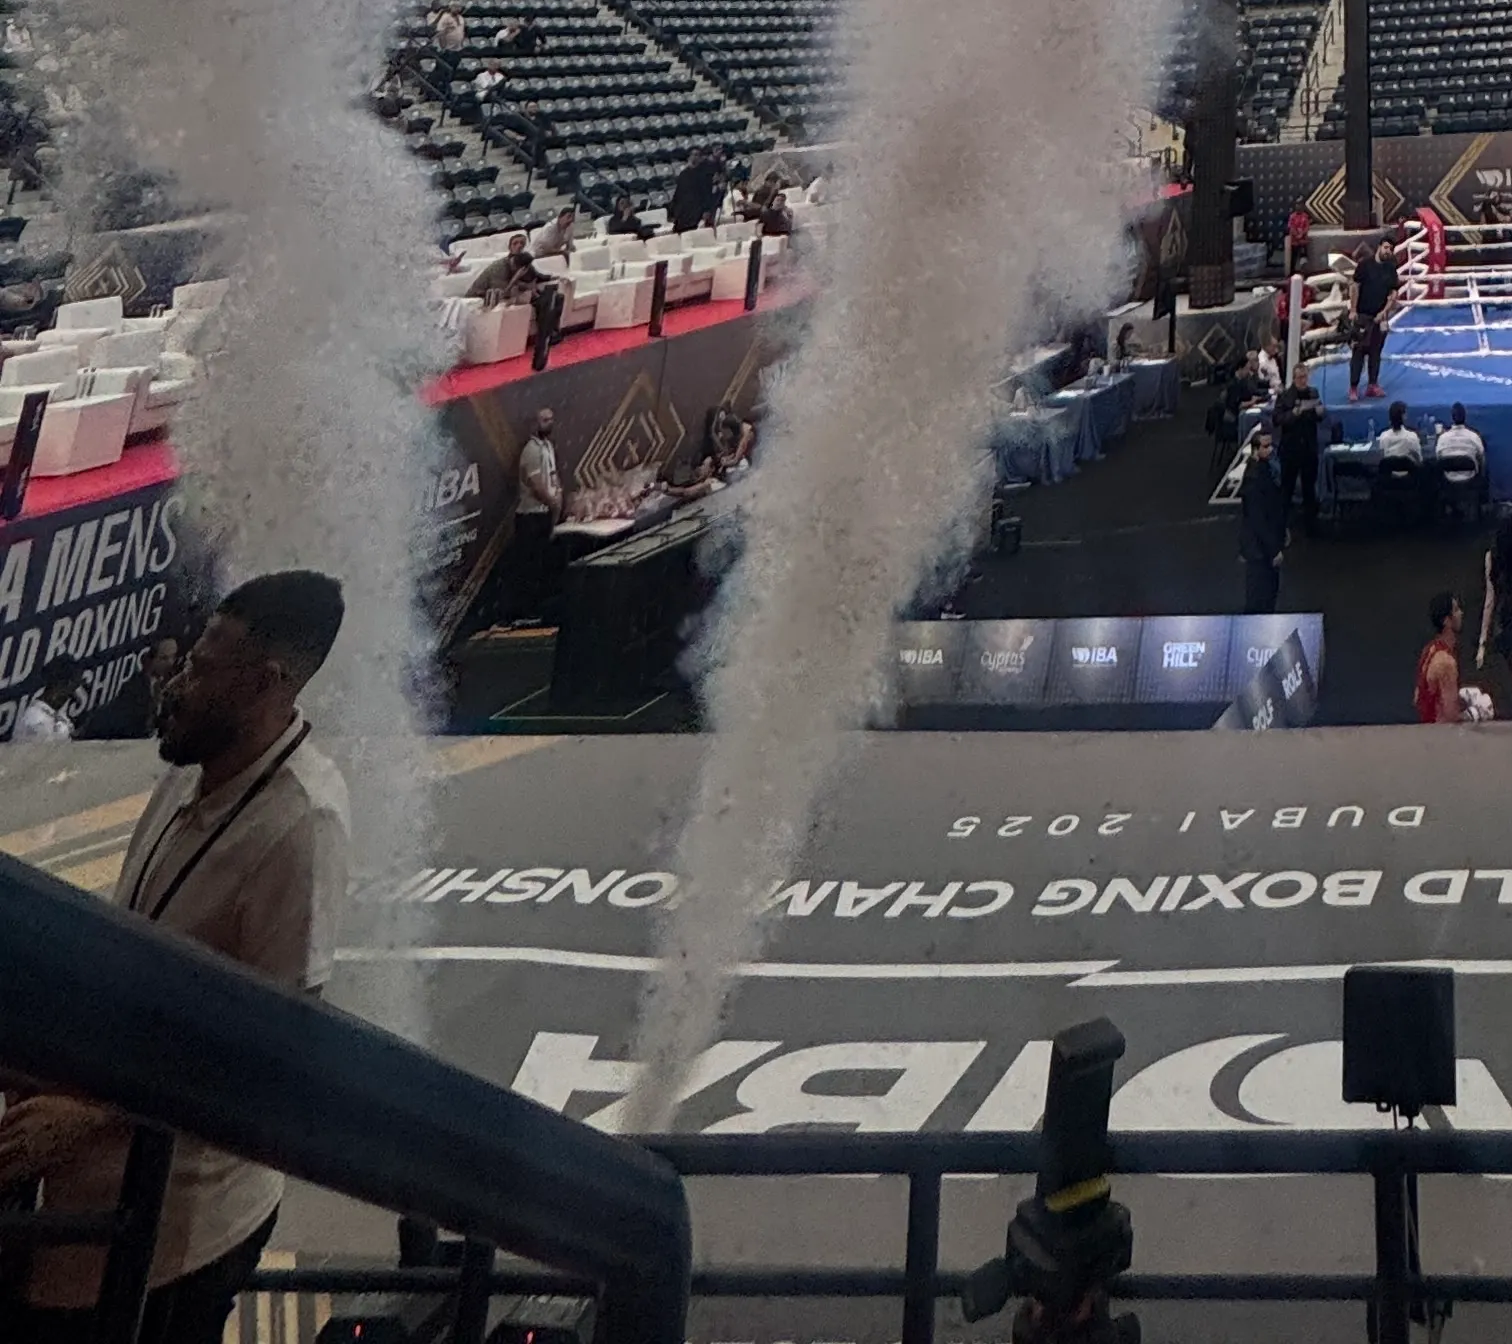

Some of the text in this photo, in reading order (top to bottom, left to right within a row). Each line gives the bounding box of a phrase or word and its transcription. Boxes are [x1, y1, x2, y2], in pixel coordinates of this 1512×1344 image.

[36, 496, 187, 613] MENS
[1162, 652, 1198, 668] HILL
[946, 805, 1426, 838] DUBAI 2025
[1031, 870, 1384, 916] BOXING
